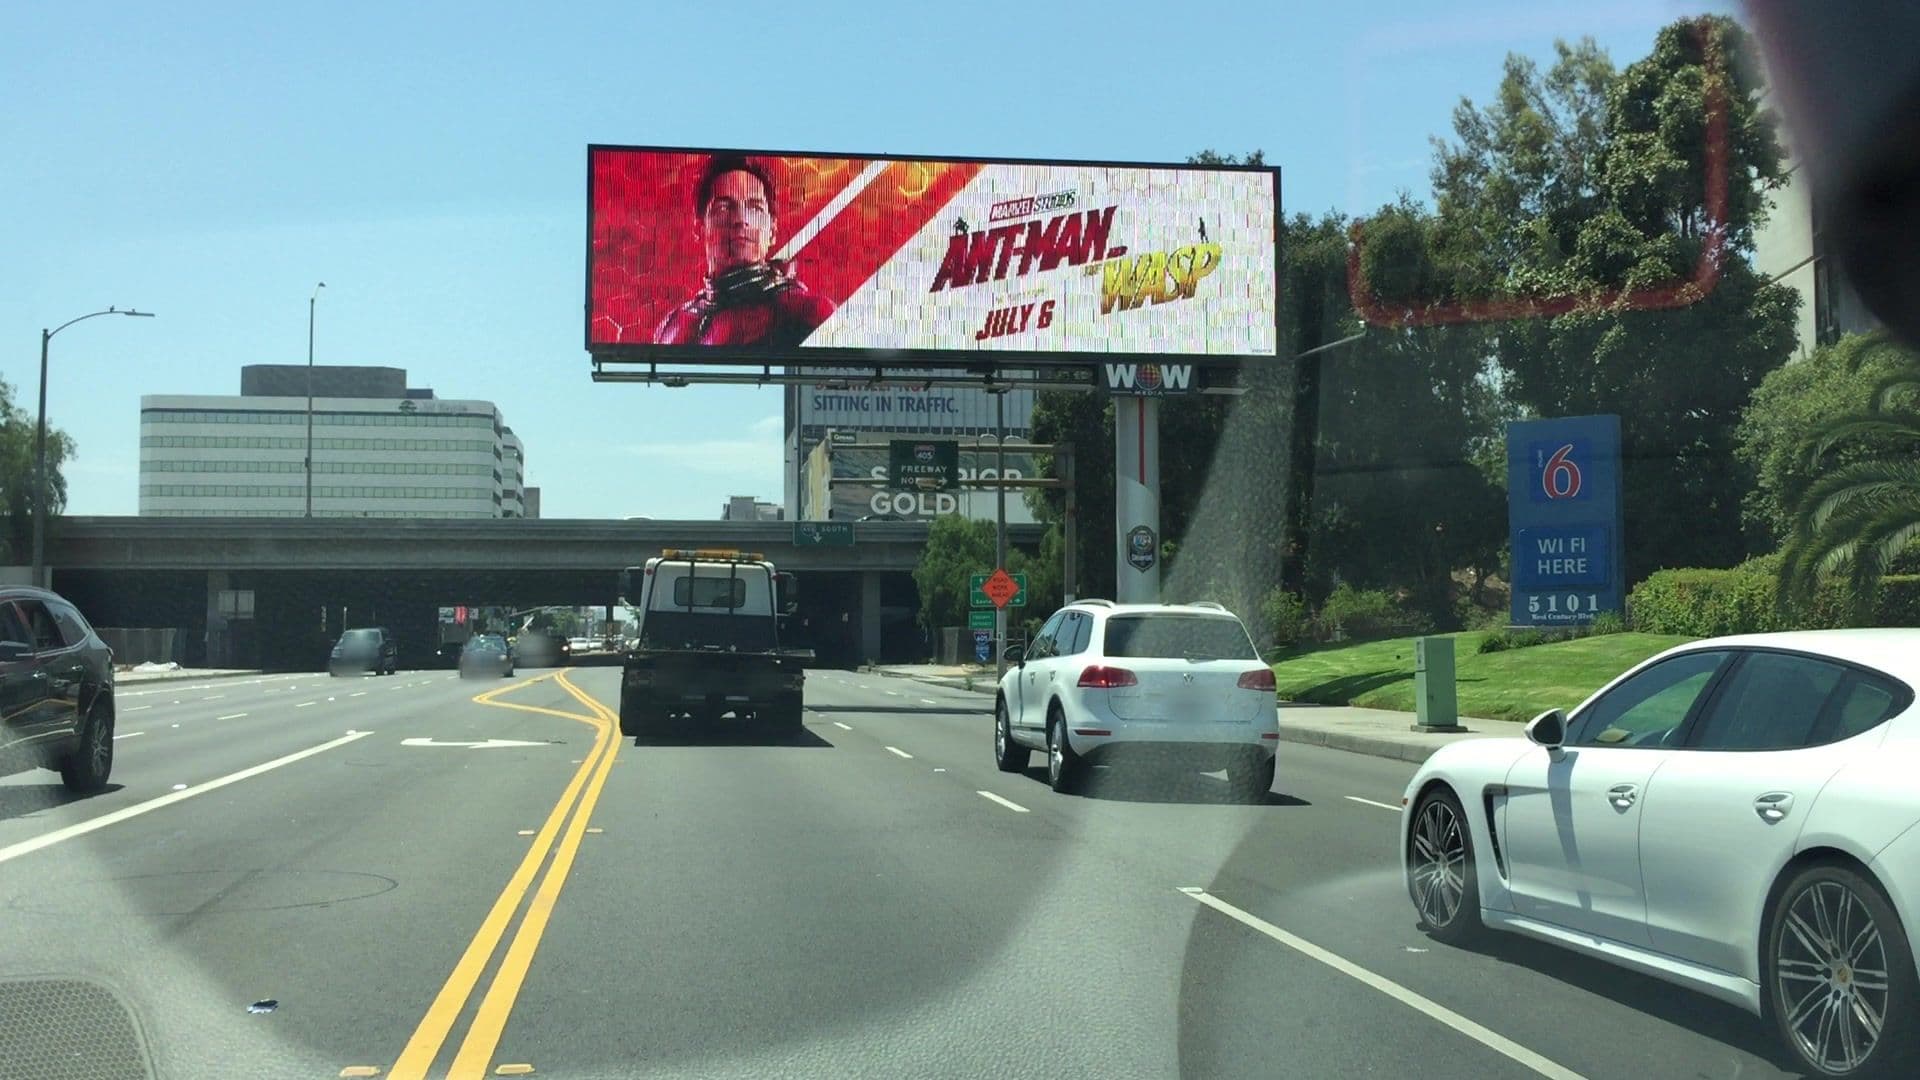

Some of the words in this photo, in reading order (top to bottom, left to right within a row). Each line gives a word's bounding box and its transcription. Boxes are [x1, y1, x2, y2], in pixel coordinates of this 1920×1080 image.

[991, 199, 1031, 220] MARVEL
[930, 205, 1118, 293] ANT-MAN
[1100, 243, 1223, 315] WASP
[975, 301, 1033, 341] JULY
[1036, 300, 1055, 329] 6
[814, 395, 869, 411] SITTING
[876, 396, 892, 412] IN
[899, 397, 959, 413] TRAFFIC.
[901, 465, 948, 473] FREEWAY
[1543, 444, 1581, 499] 6
[870, 491, 957, 515] GOLD
[1538, 539, 1563, 553] WI
[1571, 538, 1585, 552] FI
[1538, 558, 1587, 574] HERE
[1528, 594, 1599, 613] 5101
[1548, 613, 1577, 621] Century
